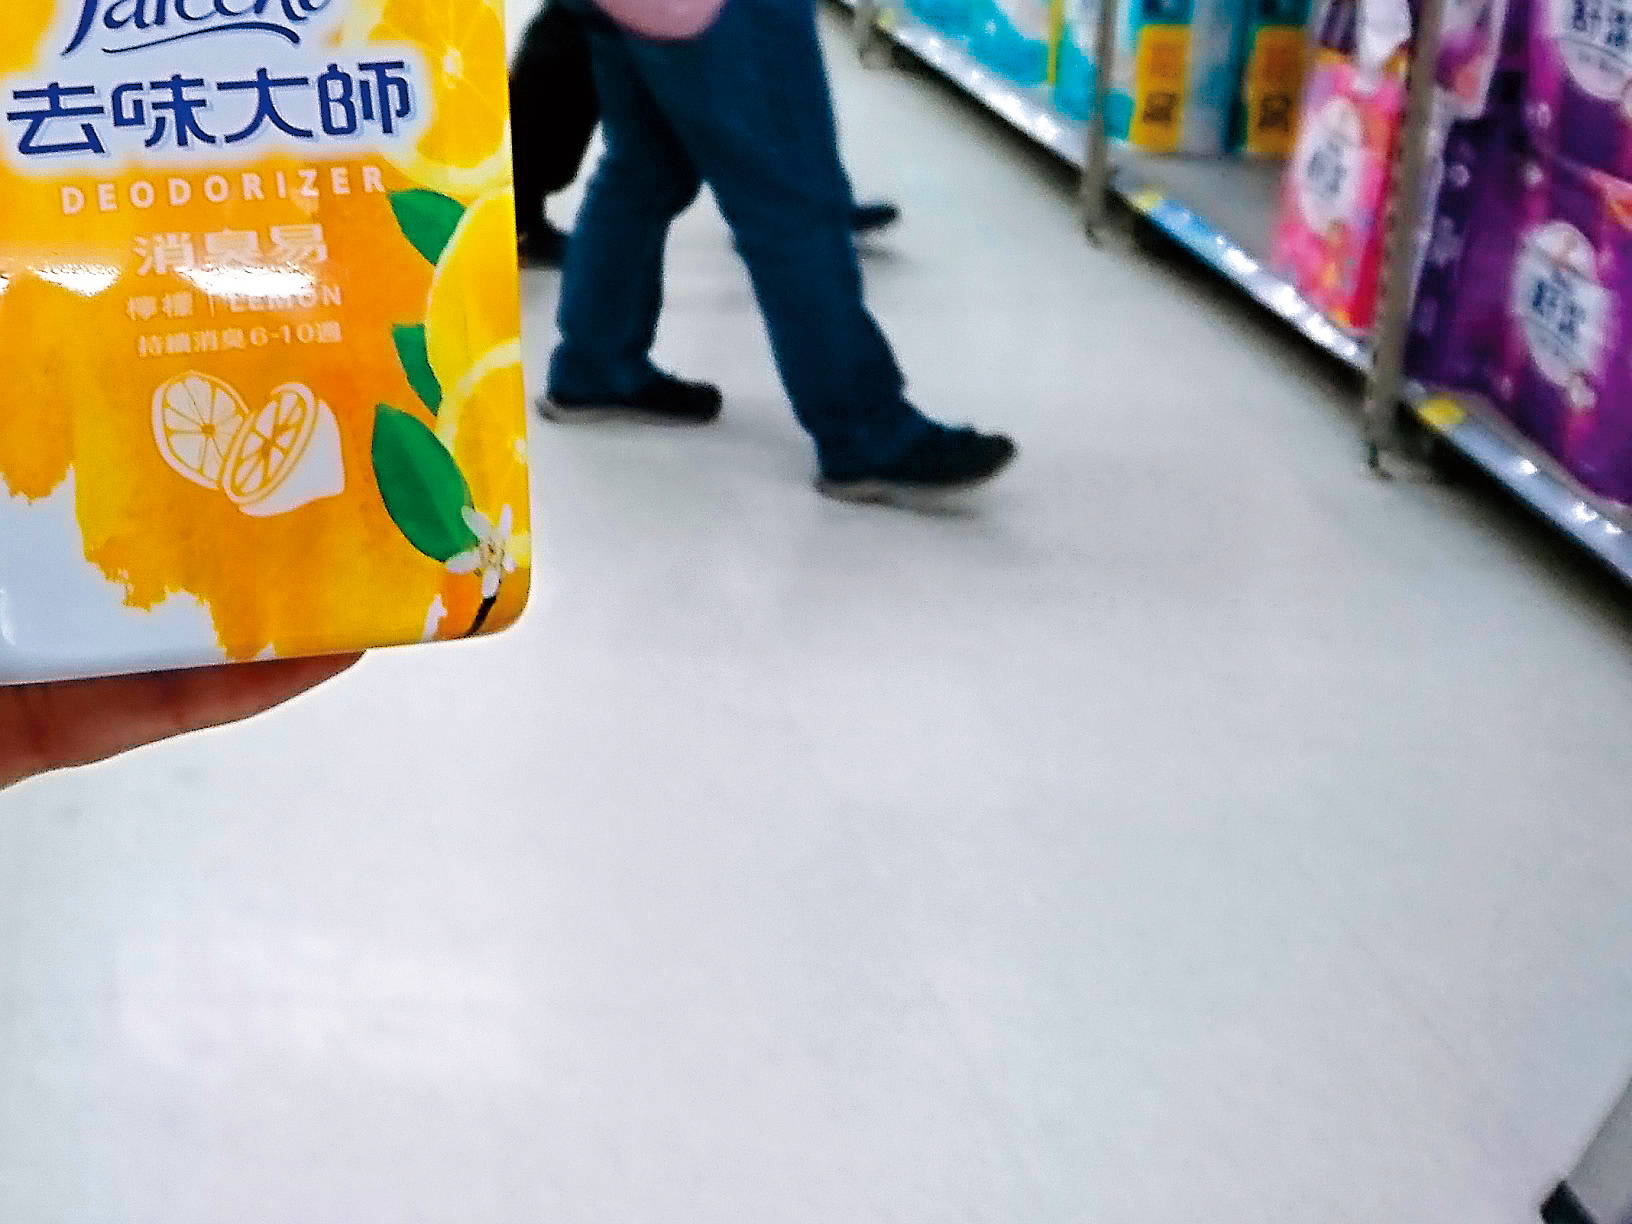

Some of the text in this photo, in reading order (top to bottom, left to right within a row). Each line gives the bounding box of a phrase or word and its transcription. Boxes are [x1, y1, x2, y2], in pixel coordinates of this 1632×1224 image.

[6, 60, 412, 157] 去味大師
[61, 165, 387, 216] DEODORIZER
